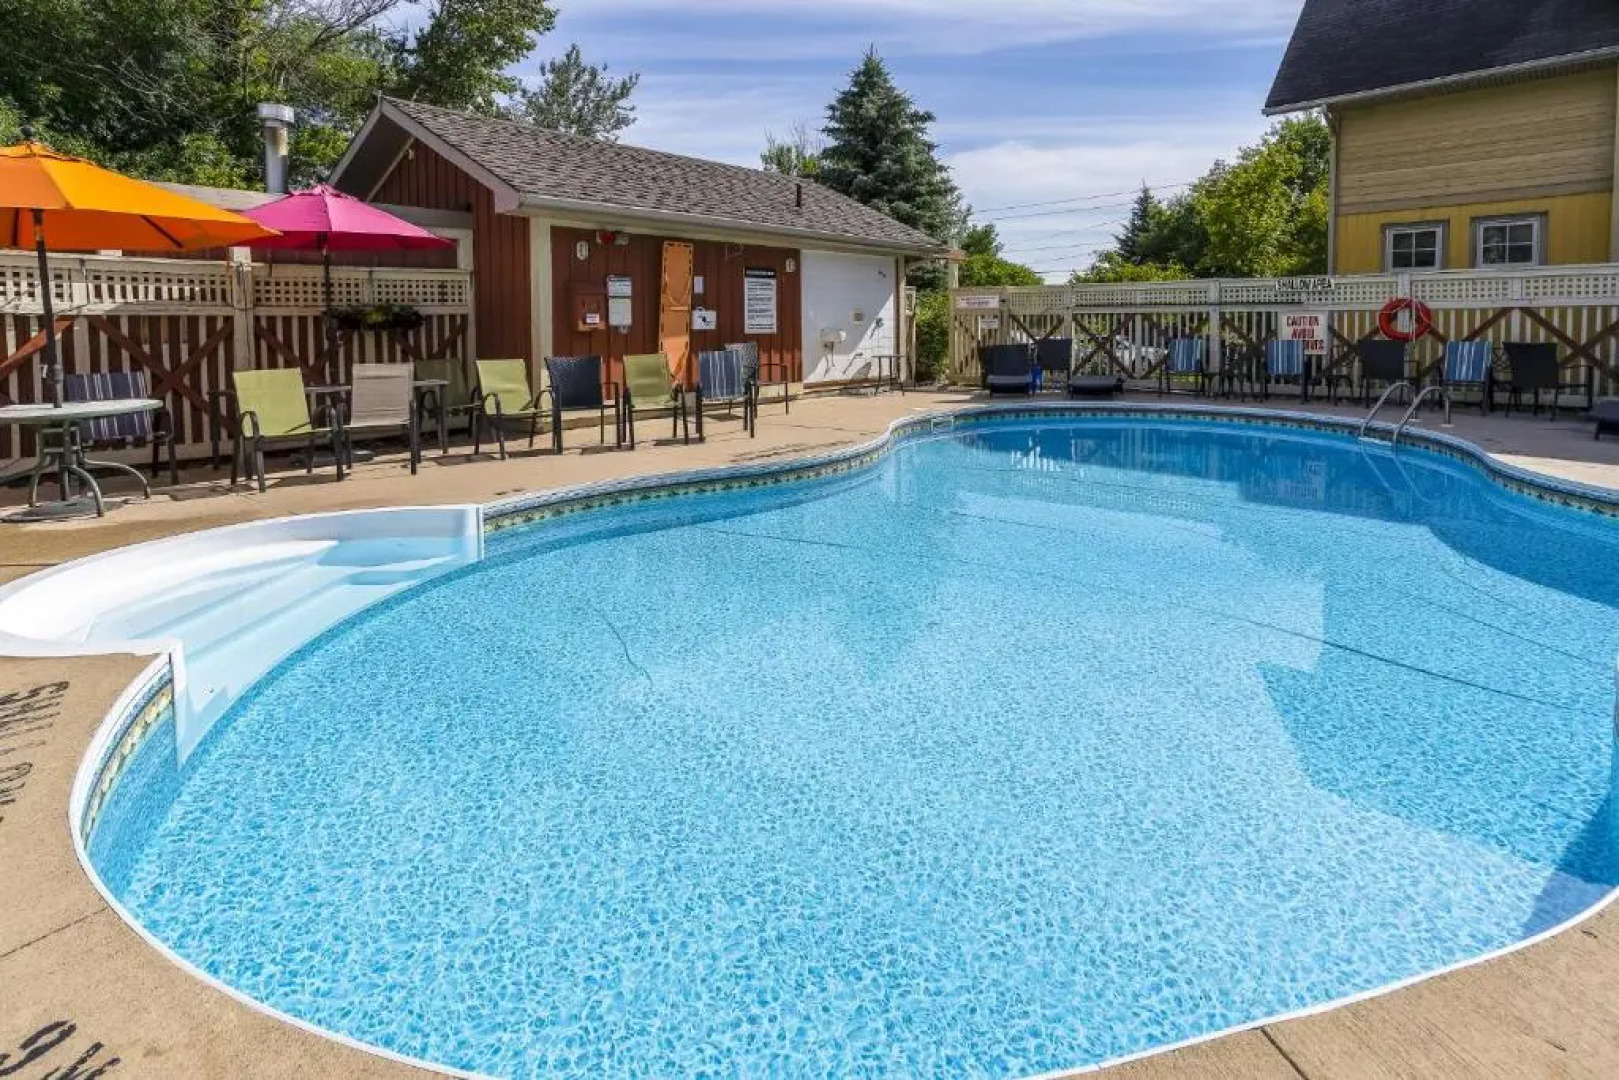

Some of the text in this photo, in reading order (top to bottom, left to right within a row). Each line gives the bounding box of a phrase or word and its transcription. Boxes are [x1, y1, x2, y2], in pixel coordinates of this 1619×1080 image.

[1277, 277, 1333, 291] SHALLOW AREA
[1286, 315, 1320, 327] CAUTION
[1291, 328, 1315, 339] AVOID
